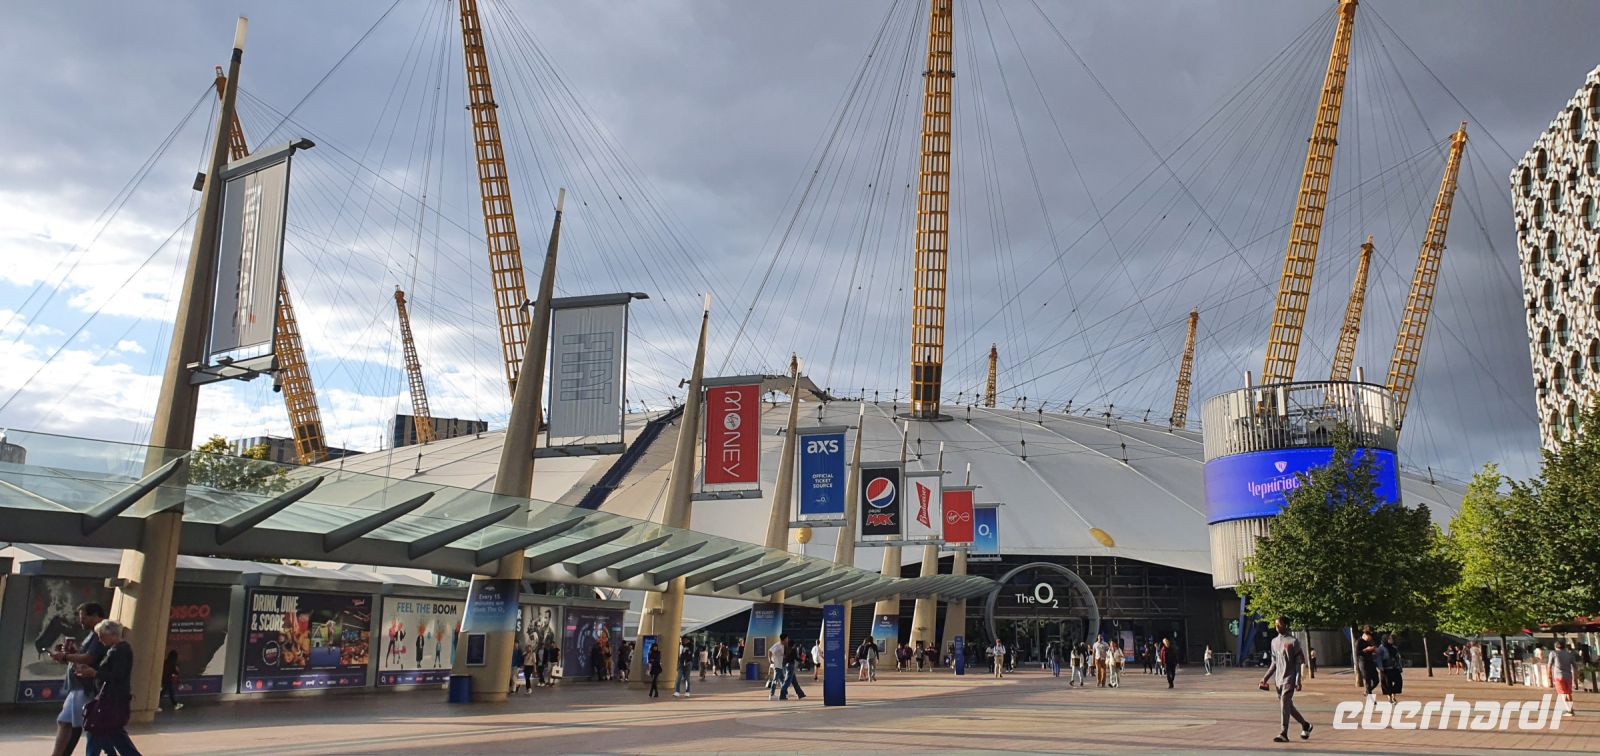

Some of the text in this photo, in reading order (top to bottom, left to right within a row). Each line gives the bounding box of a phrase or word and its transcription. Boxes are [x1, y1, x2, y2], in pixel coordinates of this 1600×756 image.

[807, 439, 839, 455] axs
[1247, 471, 1314, 500] Чернігівс
[919, 486, 928, 525] Budweiser
[252, 594, 299, 614] DRINK, DINE
[1015, 593, 1035, 604] The
[396, 602, 457, 615] FEEL THE BOOM
[250, 613, 285, 632] & SCORE
